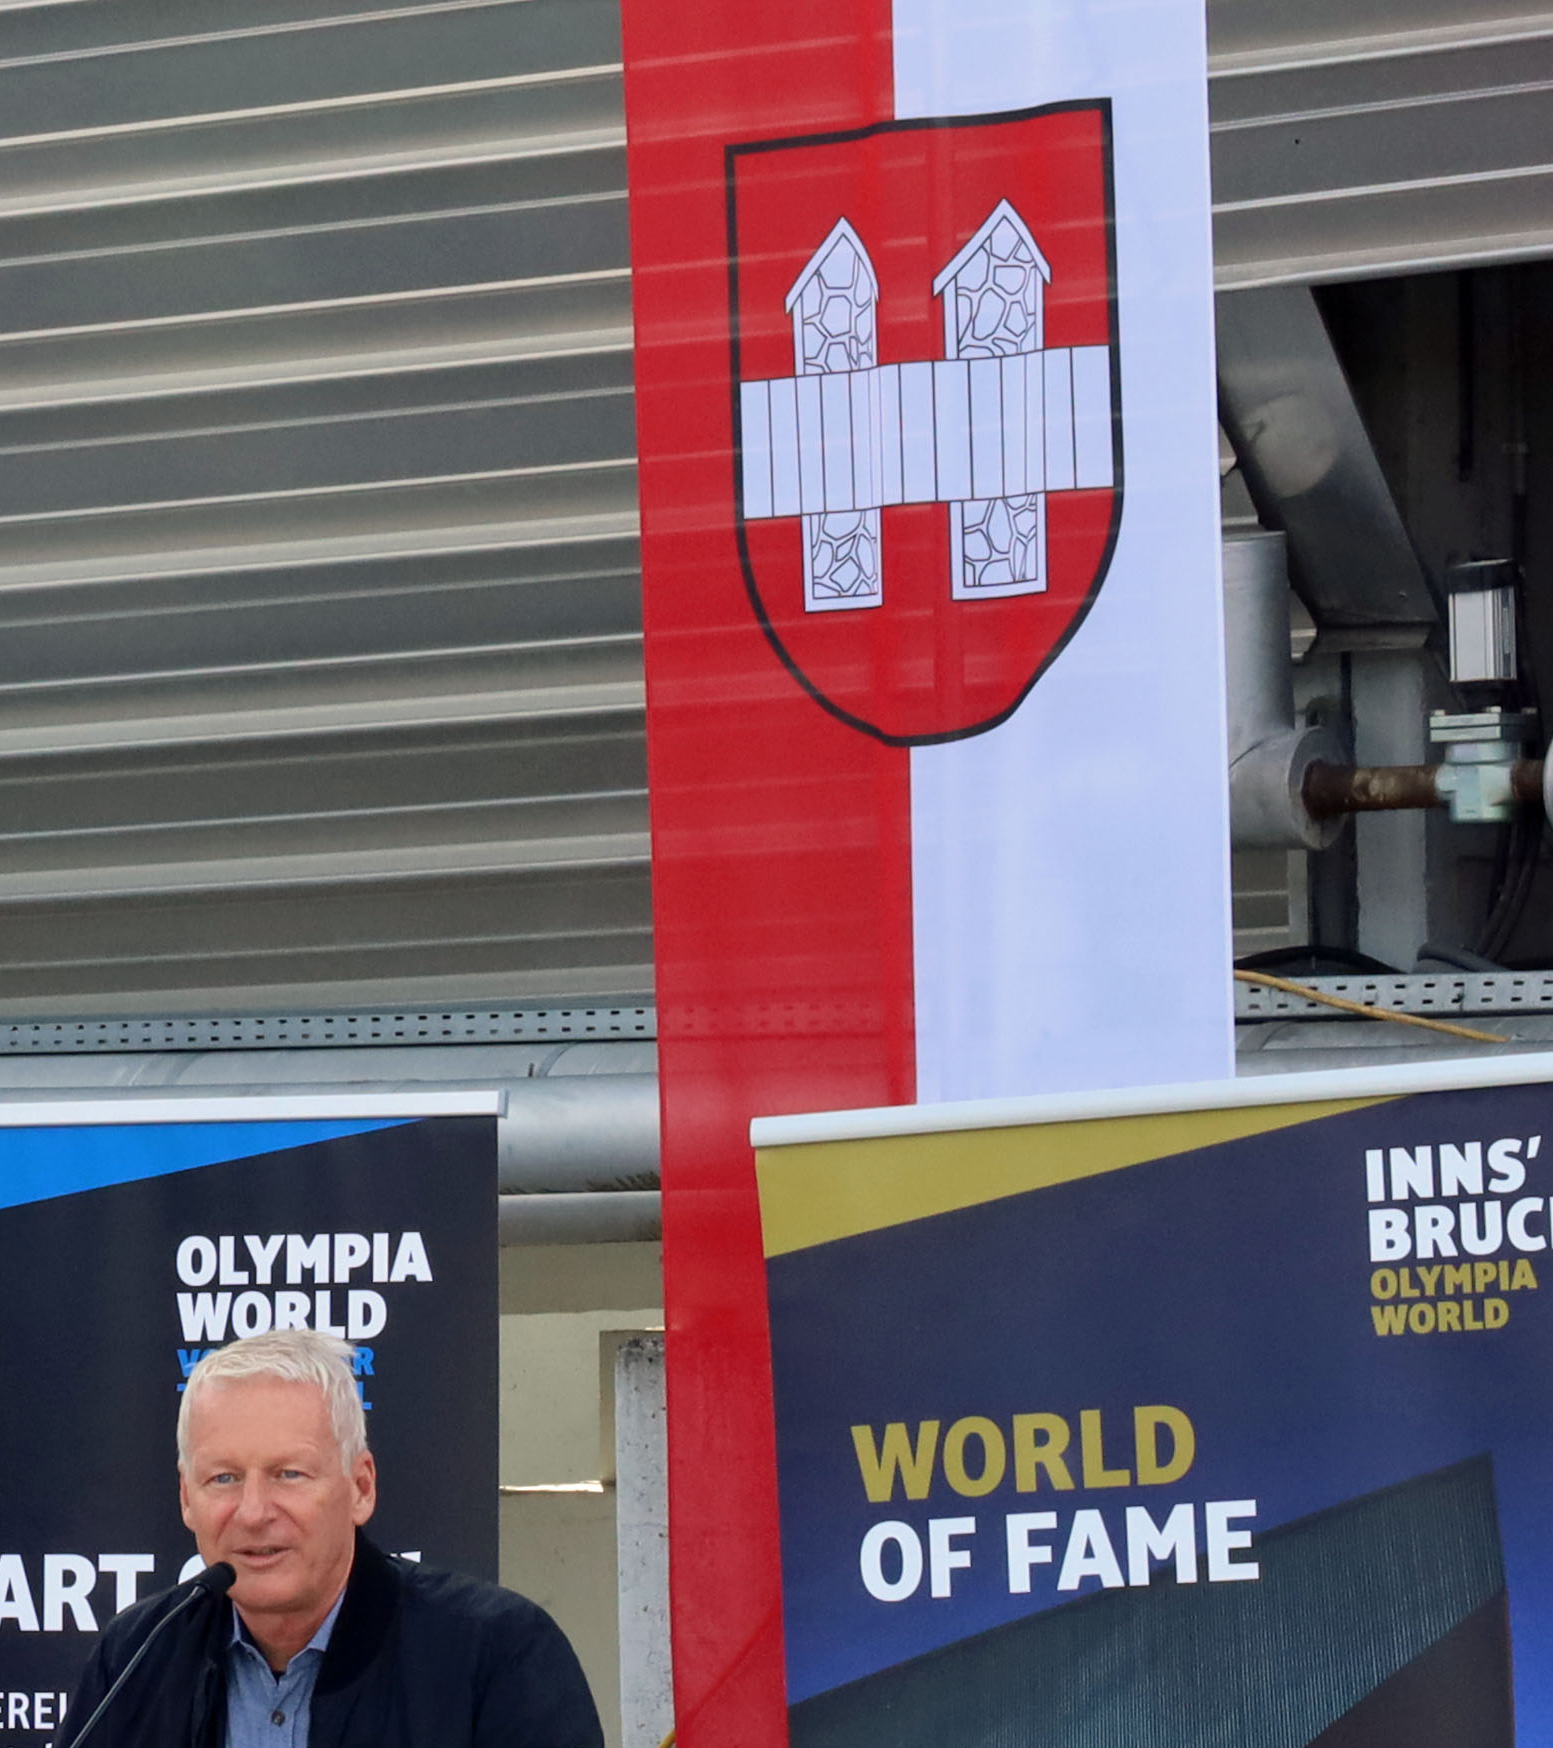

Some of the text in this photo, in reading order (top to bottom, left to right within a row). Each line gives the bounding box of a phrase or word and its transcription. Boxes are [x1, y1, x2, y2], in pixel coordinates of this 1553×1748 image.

[176, 1231, 433, 1287] OLYMPIA
[1371, 1258, 1538, 1301] OLYMPIA
[176, 1289, 388, 1342] WORLD
[1371, 1298, 1511, 1336] WORLD
[851, 1405, 1196, 1503] WORLD
[860, 1499, 1260, 1602] OF FAME
